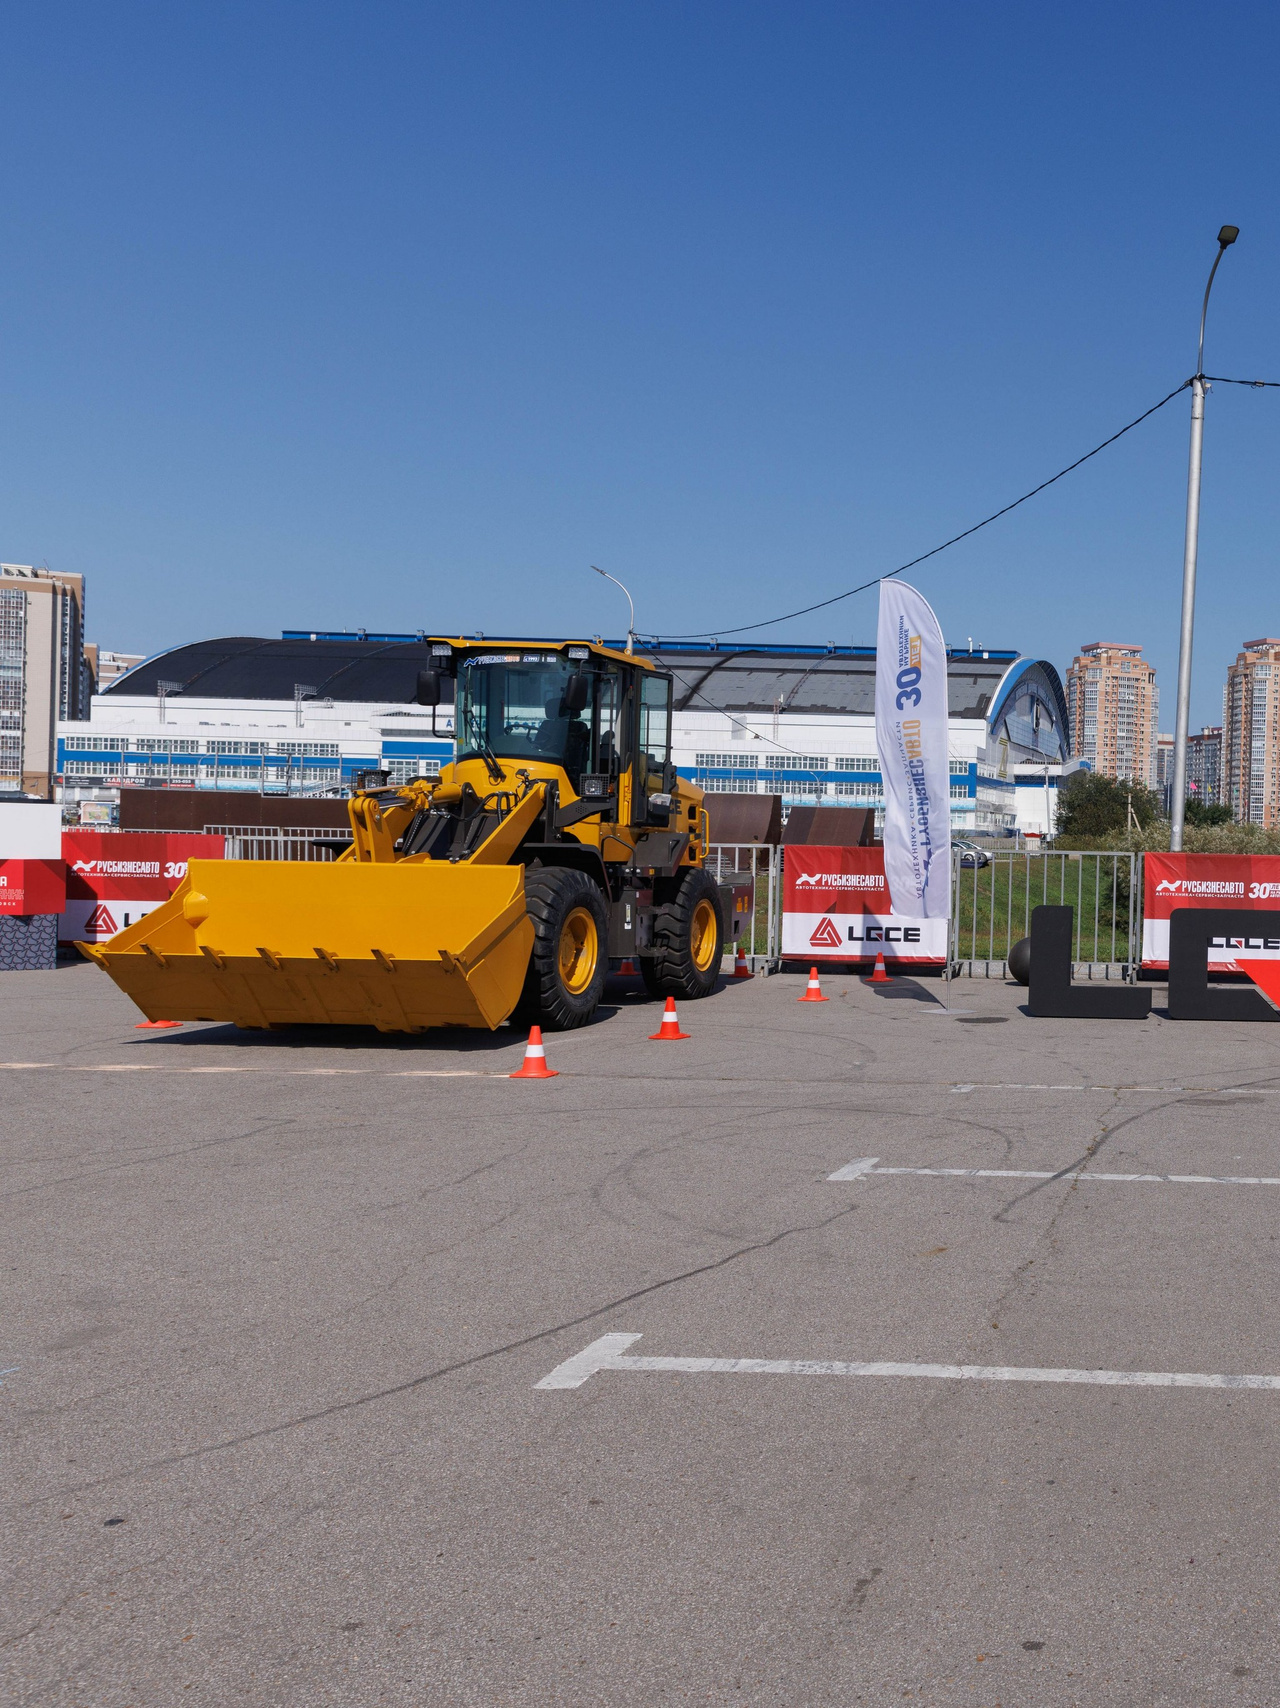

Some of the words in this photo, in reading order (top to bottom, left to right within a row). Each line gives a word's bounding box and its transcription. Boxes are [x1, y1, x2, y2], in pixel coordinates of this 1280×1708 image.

[97, 860, 160, 874] РУСБИЗНЕСАВТО
[822, 873, 885, 887] РУСБИЗНЕСАВТО
[1181, 880, 1245, 895] РУСБИЗНЕСАВТО
[1248, 882, 1271, 899] 30
